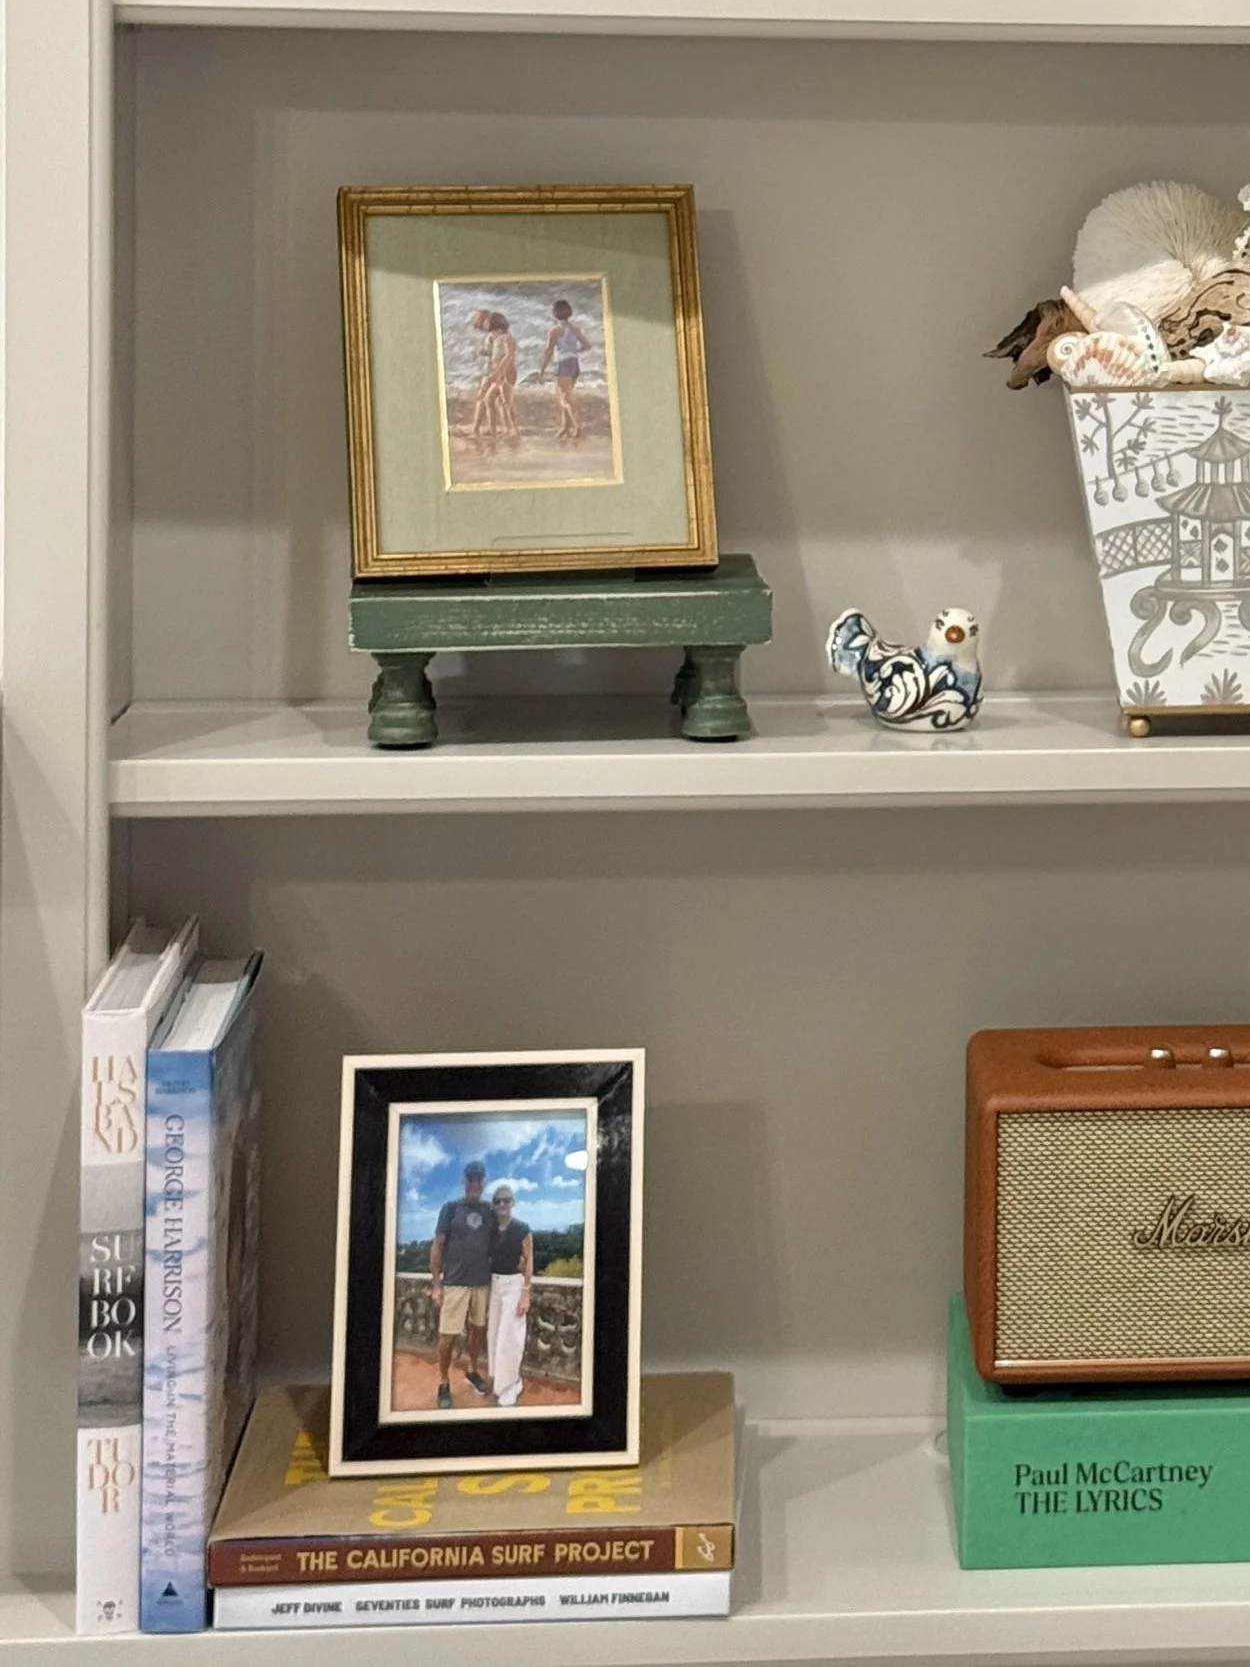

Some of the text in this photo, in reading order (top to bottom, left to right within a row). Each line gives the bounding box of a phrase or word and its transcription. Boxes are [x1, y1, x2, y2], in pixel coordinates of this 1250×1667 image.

[163, 1114, 185, 1211] GEORGE
[162, 1217, 184, 1333] HARRISON
[166, 1413, 177, 1437] THE
[165, 1442, 177, 1506] MATERIAL
[1015, 1460, 1214, 1490] Paul McCartney
[1015, 1488, 1163, 1515] THE LYRICS
[297, 1550, 338, 1572] THE
[346, 1544, 485, 1570] CALIFORNIA
[491, 1543, 546, 1565] SURF
[553, 1539, 655, 1563] PROJECT
[271, 1591, 670, 1614] JEFF DIVINE SEVENTIES SURF PHOTOGRAPHS WILLIAM FINNEGAN
